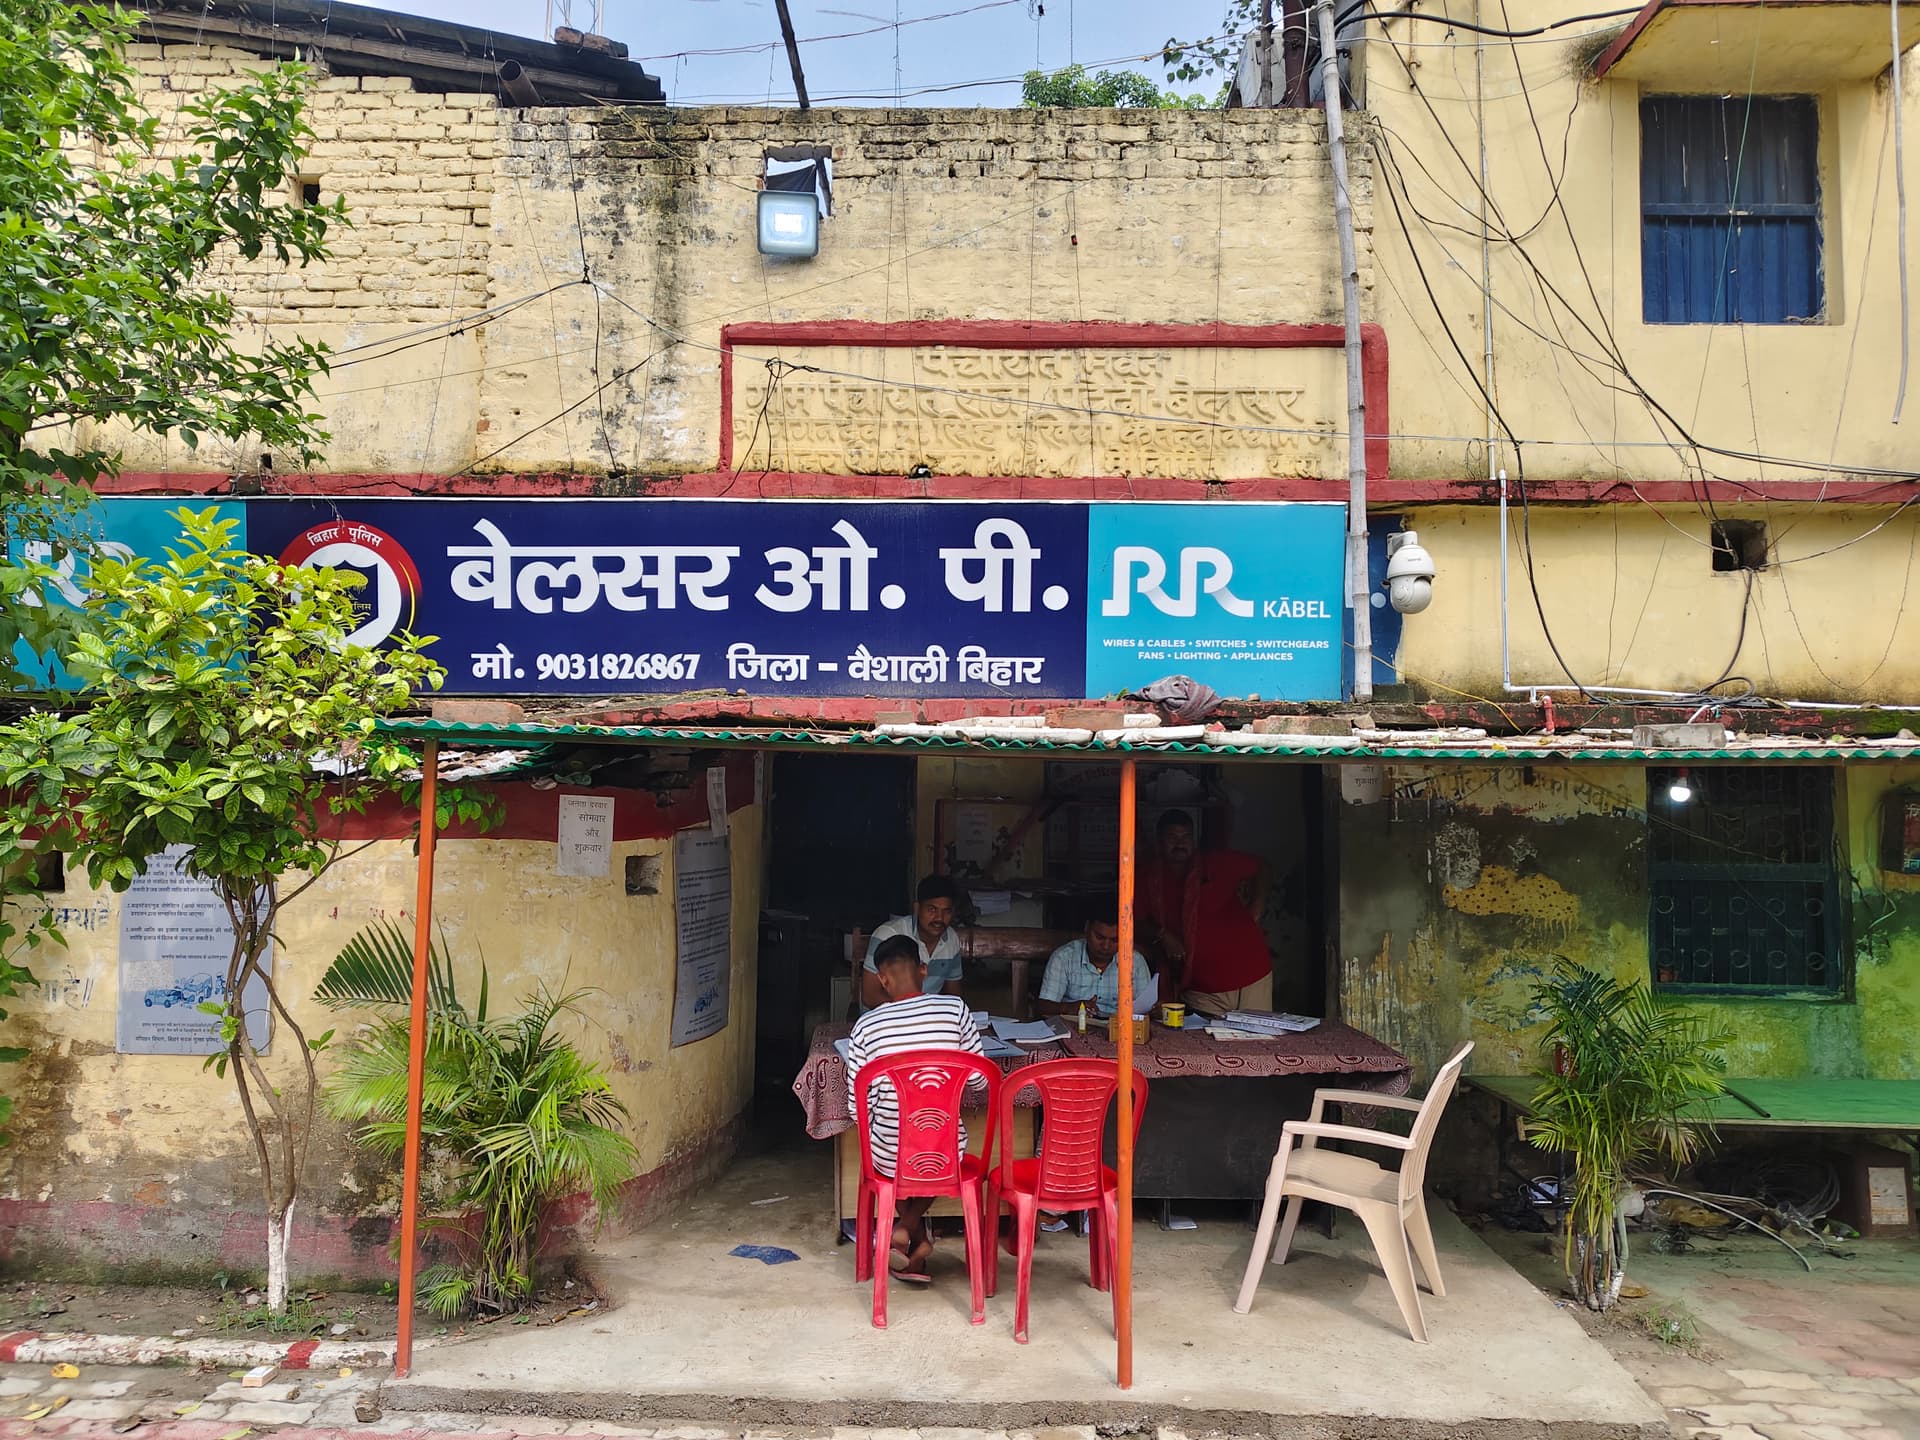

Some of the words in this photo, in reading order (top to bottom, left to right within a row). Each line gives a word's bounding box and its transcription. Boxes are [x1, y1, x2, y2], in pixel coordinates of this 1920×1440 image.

[1081, 351, 1172, 381] भवन
[306, 527, 339, 546] बिहार
[348, 525, 384, 547] पुलिस
[446, 518, 740, 614] बेलसर
[754, 518, 906, 613] ओ.
[939, 518, 1070, 613] पी.
[1263, 597, 1331, 618] KĀBEL
[1103, 639, 1136, 648] WIRES
[1137, 639, 1145, 648] &
[1147, 639, 1186, 648] CABLES
[1195, 640, 1247, 648] SWITCHES
[1256, 640, 1329, 650] SWITCHGEARS
[471, 642, 525, 681] मो.
[537, 653, 701, 681] 9031826867
[726, 642, 809, 681] जिला
[847, 643, 950, 684] वैशाली
[957, 644, 1046, 684] बिहार
[1138, 651, 1165, 660] FANS
[1174, 652, 1222, 661] LIGHTING
[1230, 652, 1294, 661] APPLIANCES
[584, 827, 600, 838] और
